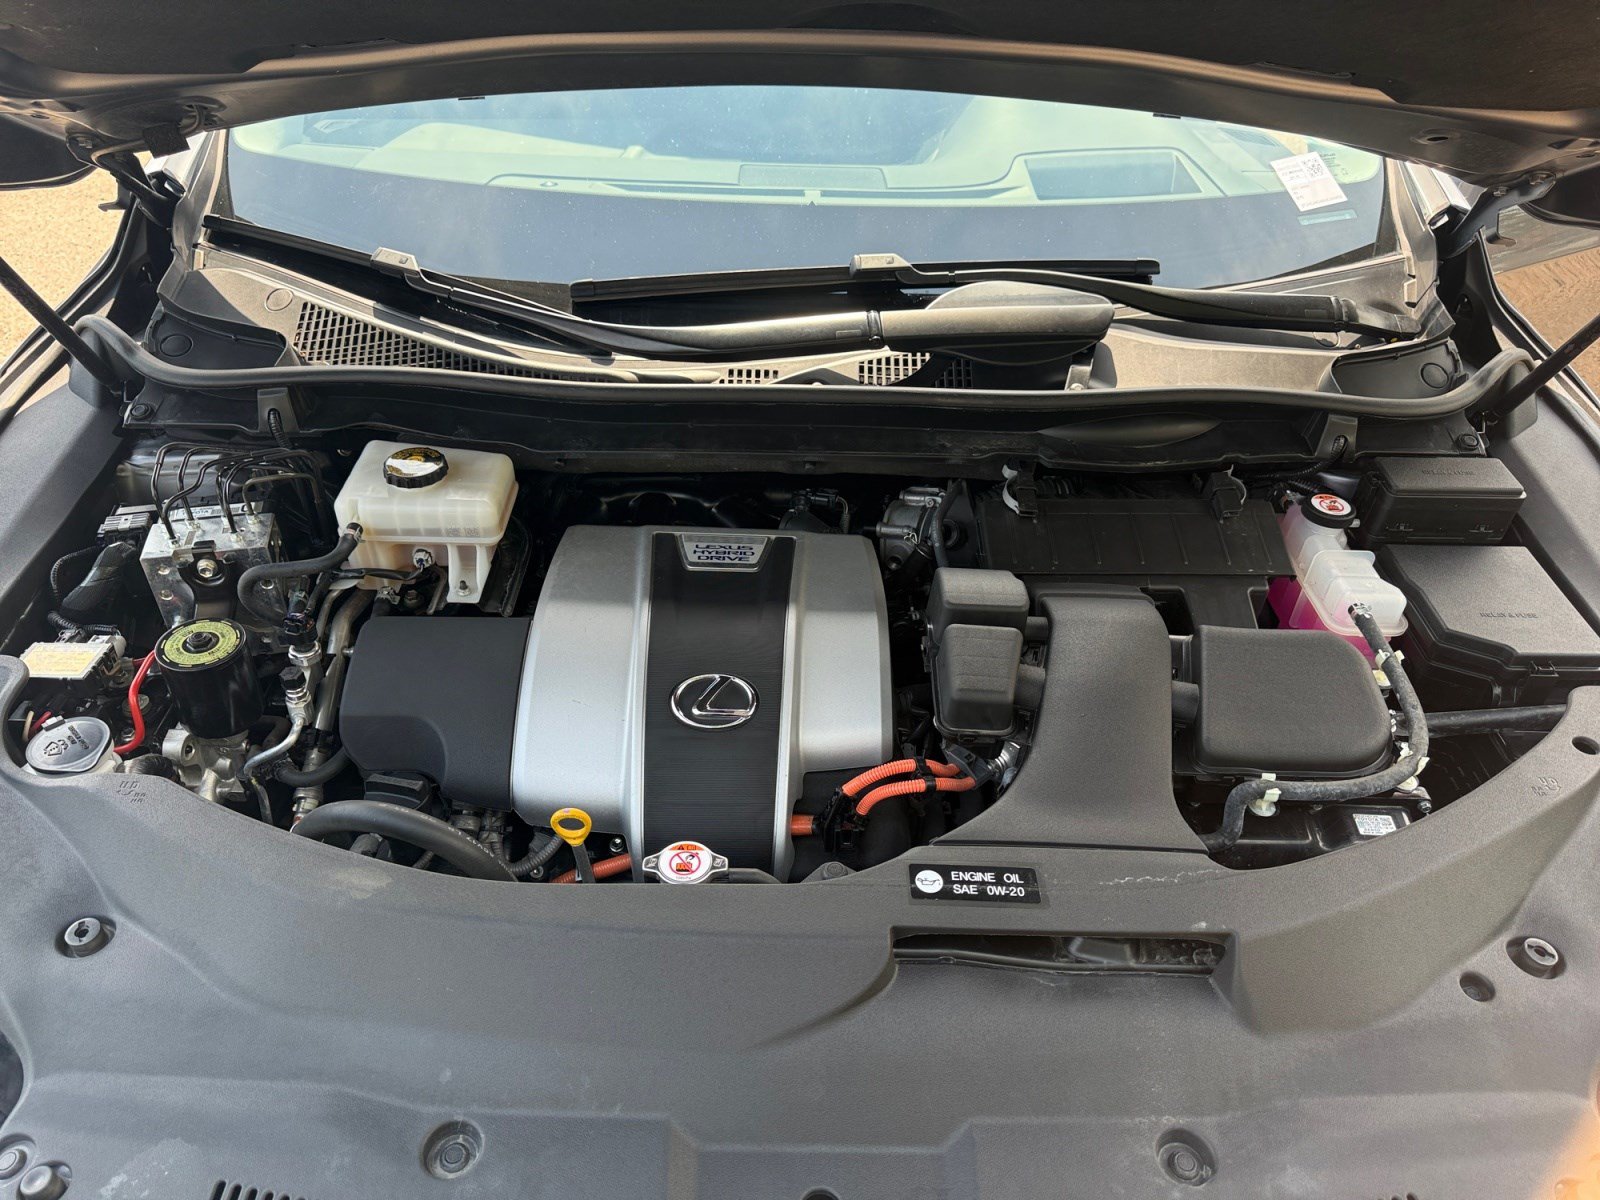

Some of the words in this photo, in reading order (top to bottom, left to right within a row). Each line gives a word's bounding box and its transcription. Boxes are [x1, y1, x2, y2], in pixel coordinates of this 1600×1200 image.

[951, 871, 996, 882] ENGINE
[1003, 873, 1024, 883] OIL
[953, 884, 978, 895] SAE
[987, 885, 1025, 897] 0W-20
